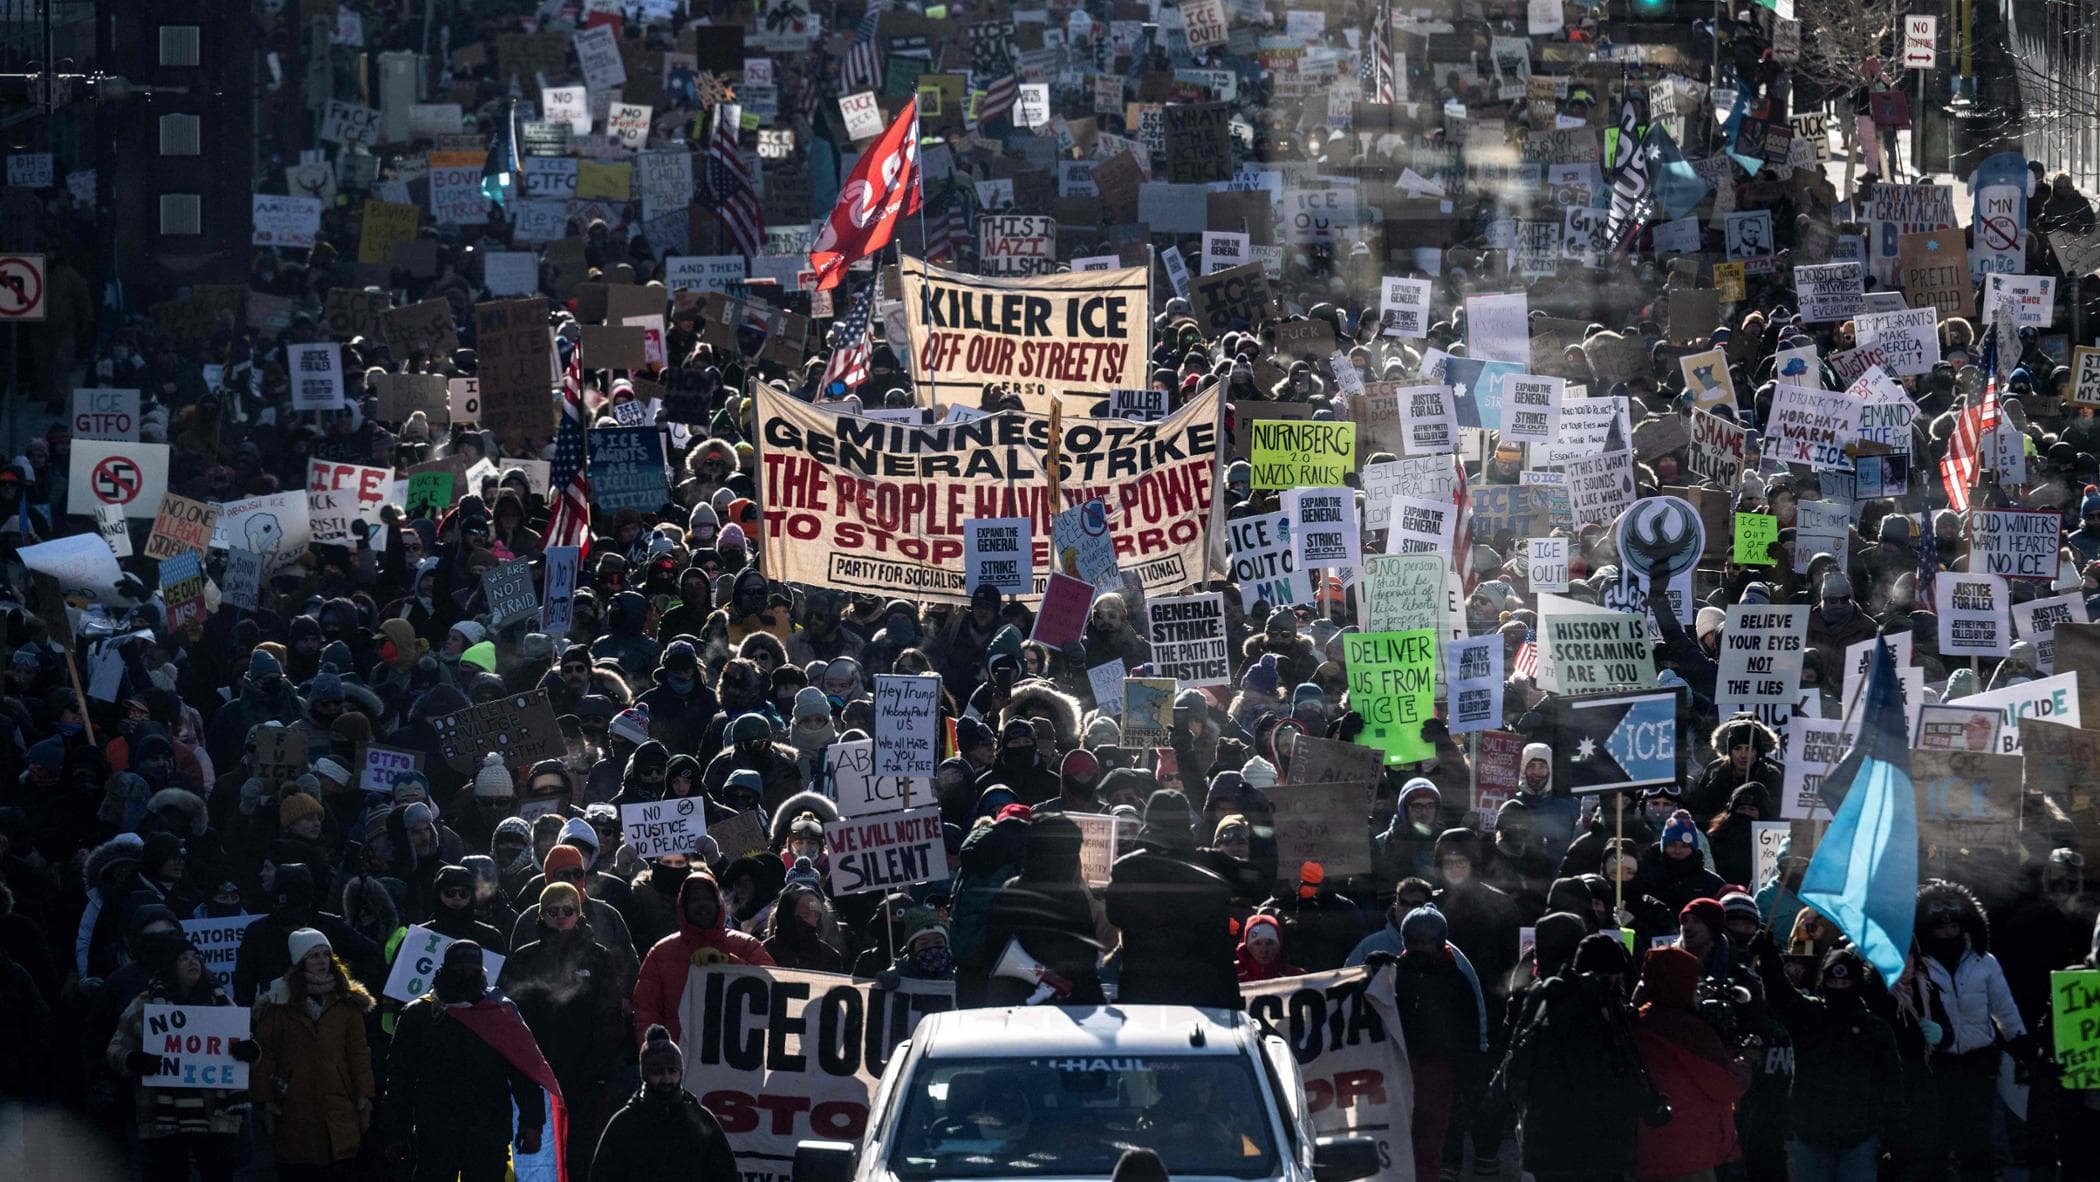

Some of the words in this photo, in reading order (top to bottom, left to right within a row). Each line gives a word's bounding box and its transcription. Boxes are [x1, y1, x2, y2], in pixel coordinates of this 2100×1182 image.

[1185, 8, 1219, 28] ICE
[1912, 22, 1928, 34] NO
[1189, 24, 1223, 45] OUT!
[1906, 38, 1934, 49] STOPPING
[842, 91, 875, 113] FUCK
[621, 107, 642, 118] NO
[335, 126, 368, 144] ICE
[618, 129, 638, 140] NO
[1791, 115, 1827, 138] FUCK
[538, 161, 569, 170] ICE
[1297, 192, 1338, 210] ICE
[1872, 187, 1901, 200] MAKE
[1903, 186, 1949, 202] AMERICA
[1876, 201, 1915, 221] GREAT
[1988, 199, 2013, 214] MN
[982, 218, 1034, 237] THIS
[1037, 217, 1056, 238] IS
[985, 239, 1046, 257] NAZI
[679, 264, 705, 275] AND
[709, 264, 743, 274] THEN
[1911, 266, 1960, 288] PRETTI
[708, 278, 742, 288] CAME
[1197, 271, 1268, 312] ICE
[1914, 290, 1961, 313] GOOD
[921, 286, 1052, 337] KILLER
[1066, 297, 1128, 338] ICE
[1210, 299, 1268, 329] OUT
[1856, 311, 1935, 333] IMMIGRANTS
[920, 332, 966, 372] OFF
[965, 332, 1016, 378] OUR
[1018, 341, 1129, 384] STREETS!
[89, 394, 124, 412] ICE
[1117, 391, 1162, 410] KILLER
[1514, 392, 1551, 406] GENERAL
[76, 413, 132, 433] GTFO
[836, 415, 1160, 453] MINNESOTA
[1694, 411, 1745, 458] SHAME
[764, 417, 1034, 480] GENERAL
[1043, 421, 1216, 481] STRIKE
[1594, 459, 1602, 471] IS
[1603, 454, 1628, 470] WHAT
[411, 475, 442, 488] FUCK
[1253, 464, 1296, 487] NAZIS
[1523, 474, 1540, 484] TO
[1540, 474, 1563, 483] ICE
[409, 490, 438, 505] ICE
[764, 454, 829, 512] THE
[836, 474, 965, 538] PEOPLE
[1119, 460, 1215, 529] POWE
[1301, 496, 1330, 509] EXPAND
[1330, 496, 1342, 507] THE
[164, 497, 184, 518] NO
[186, 506, 216, 528] ONE
[227, 500, 262, 518] ABOLISH
[270, 497, 287, 508] ICE
[1302, 507, 1343, 523] GENERAL
[1579, 506, 1608, 525] DOVES
[155, 515, 203, 546] ILLEGAL
[977, 527, 1007, 538] EXPAND
[1007, 526, 1019, 538] THE
[1402, 516, 1443, 536] GENERAL
[1741, 517, 1770, 527] ICE
[1971, 513, 2000, 533] COLD
[2005, 515, 2058, 534] WINTERS
[764, 511, 822, 541] TO
[834, 521, 966, 566] STOP
[1232, 520, 1273, 552] ICE
[1306, 532, 1343, 547] STRIKE!
[1743, 529, 1766, 539] OUT
[977, 538, 1020, 553] GENERAL
[1747, 540, 1765, 549] OF
[1971, 535, 2000, 552] WARM
[2009, 535, 2058, 554] HEARTS
[487, 568, 504, 585] WE
[506, 562, 526, 579] ARE
[837, 558, 877, 581] PARTY
[878, 560, 903, 584] FOR
[980, 560, 1017, 575] STRIKE!
[1377, 558, 1401, 577] NO
[1403, 560, 1440, 574] person
[1987, 553, 2012, 574] NO
[2017, 554, 2047, 575] ICE
[165, 586, 181, 605] ICE
[181, 576, 201, 598] OUT
[491, 578, 522, 601] NOT
[1953, 582, 1992, 598] JUSTICE
[175, 601, 197, 622] MSP
[1150, 600, 1222, 623] GENERAL
[1952, 596, 1971, 610] FOR
[1971, 597, 1995, 611] ALEX
[2031, 603, 2070, 621] JUSTICE
[1153, 619, 1223, 642] STRIKE:
[1555, 621, 1620, 641] HISTORY
[1629, 619, 1644, 638] IS
[1740, 614, 1793, 629] BELIEVE
[1155, 646, 1177, 662] THE
[1178, 641, 1208, 660] PATH
[1210, 640, 1225, 656] TO
[1351, 636, 1432, 665] DELIVER
[1556, 642, 1647, 662] SCREAMING
[1729, 634, 1761, 651] YOUR
[1767, 635, 1800, 650] EYES
[1160, 659, 1228, 682] JUSTICE
[1566, 665, 1596, 683] ARE
[1606, 664, 1638, 682] YOU
[1748, 656, 1774, 672] NOT
[1354, 671, 1373, 694] US
[1381, 667, 1432, 695] FROM
[1727, 680, 1753, 695] THE
[1756, 680, 1784, 695] LIES
[878, 681, 902, 711] Hey
[901, 681, 936, 705] Trump
[1361, 696, 1418, 725] ICE
[1124, 729, 1171, 738] MINNESOTA
[1624, 719, 1674, 762] ICE
[368, 752, 410, 768] GTFO
[642, 805, 661, 822] NO
[629, 819, 689, 839] JUSTICE
[827, 828, 856, 854] WE
[856, 823, 895, 850] WILL
[896, 819, 922, 847] NOT
[924, 816, 942, 839] BE
[653, 834, 697, 854] PEACE
[838, 844, 933, 892] SILENT
[149, 1010, 188, 1036] NO
[701, 973, 810, 1073] ICE
[701, 1090, 871, 1140] STO
